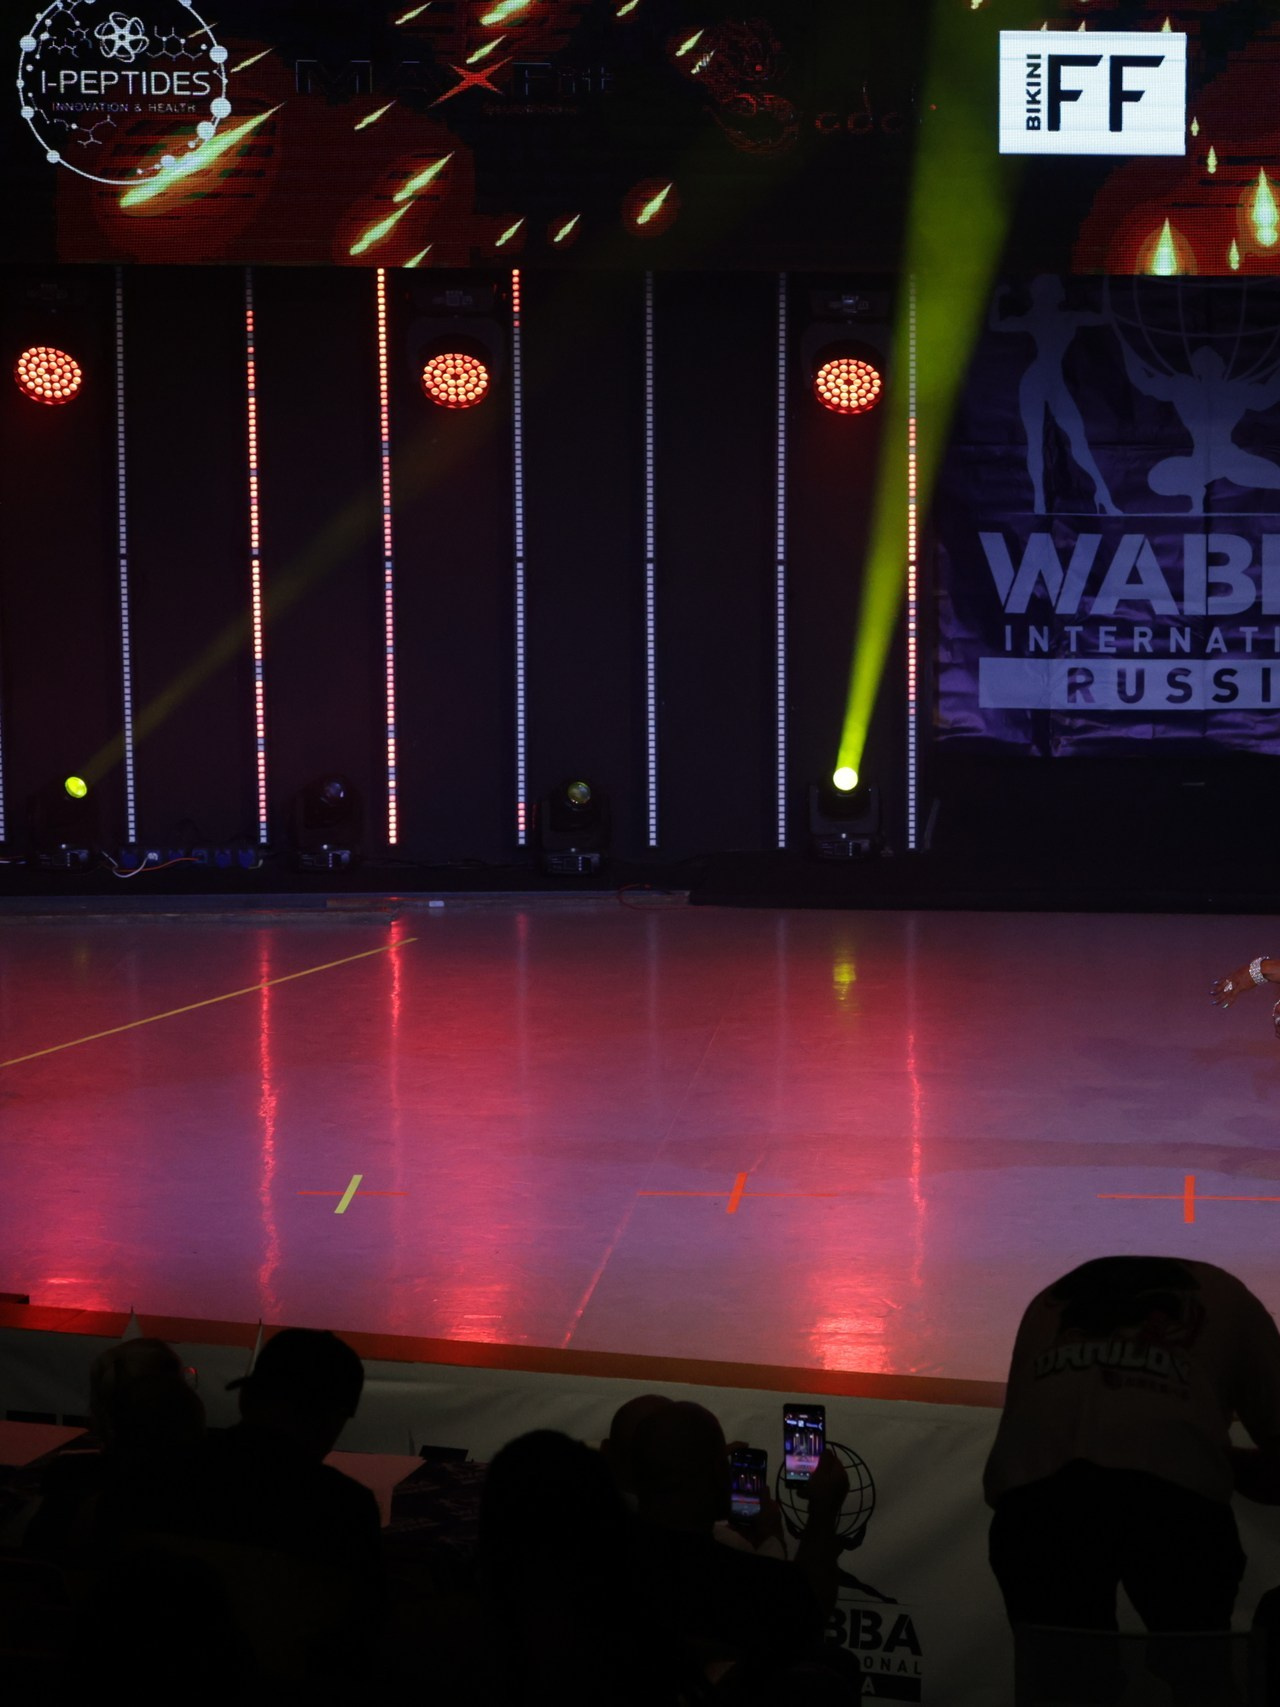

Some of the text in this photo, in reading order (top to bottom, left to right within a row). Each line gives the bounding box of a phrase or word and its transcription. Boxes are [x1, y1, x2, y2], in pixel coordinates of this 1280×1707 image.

[40, 70, 212, 95] I-PEPTIDES
[1026, 54, 1042, 130] BIKINI
[1047, 54, 1166, 132] FF
[52, 102, 197, 113] INNOVATION & HEALTH
[823, 1608, 922, 1656] BBA
